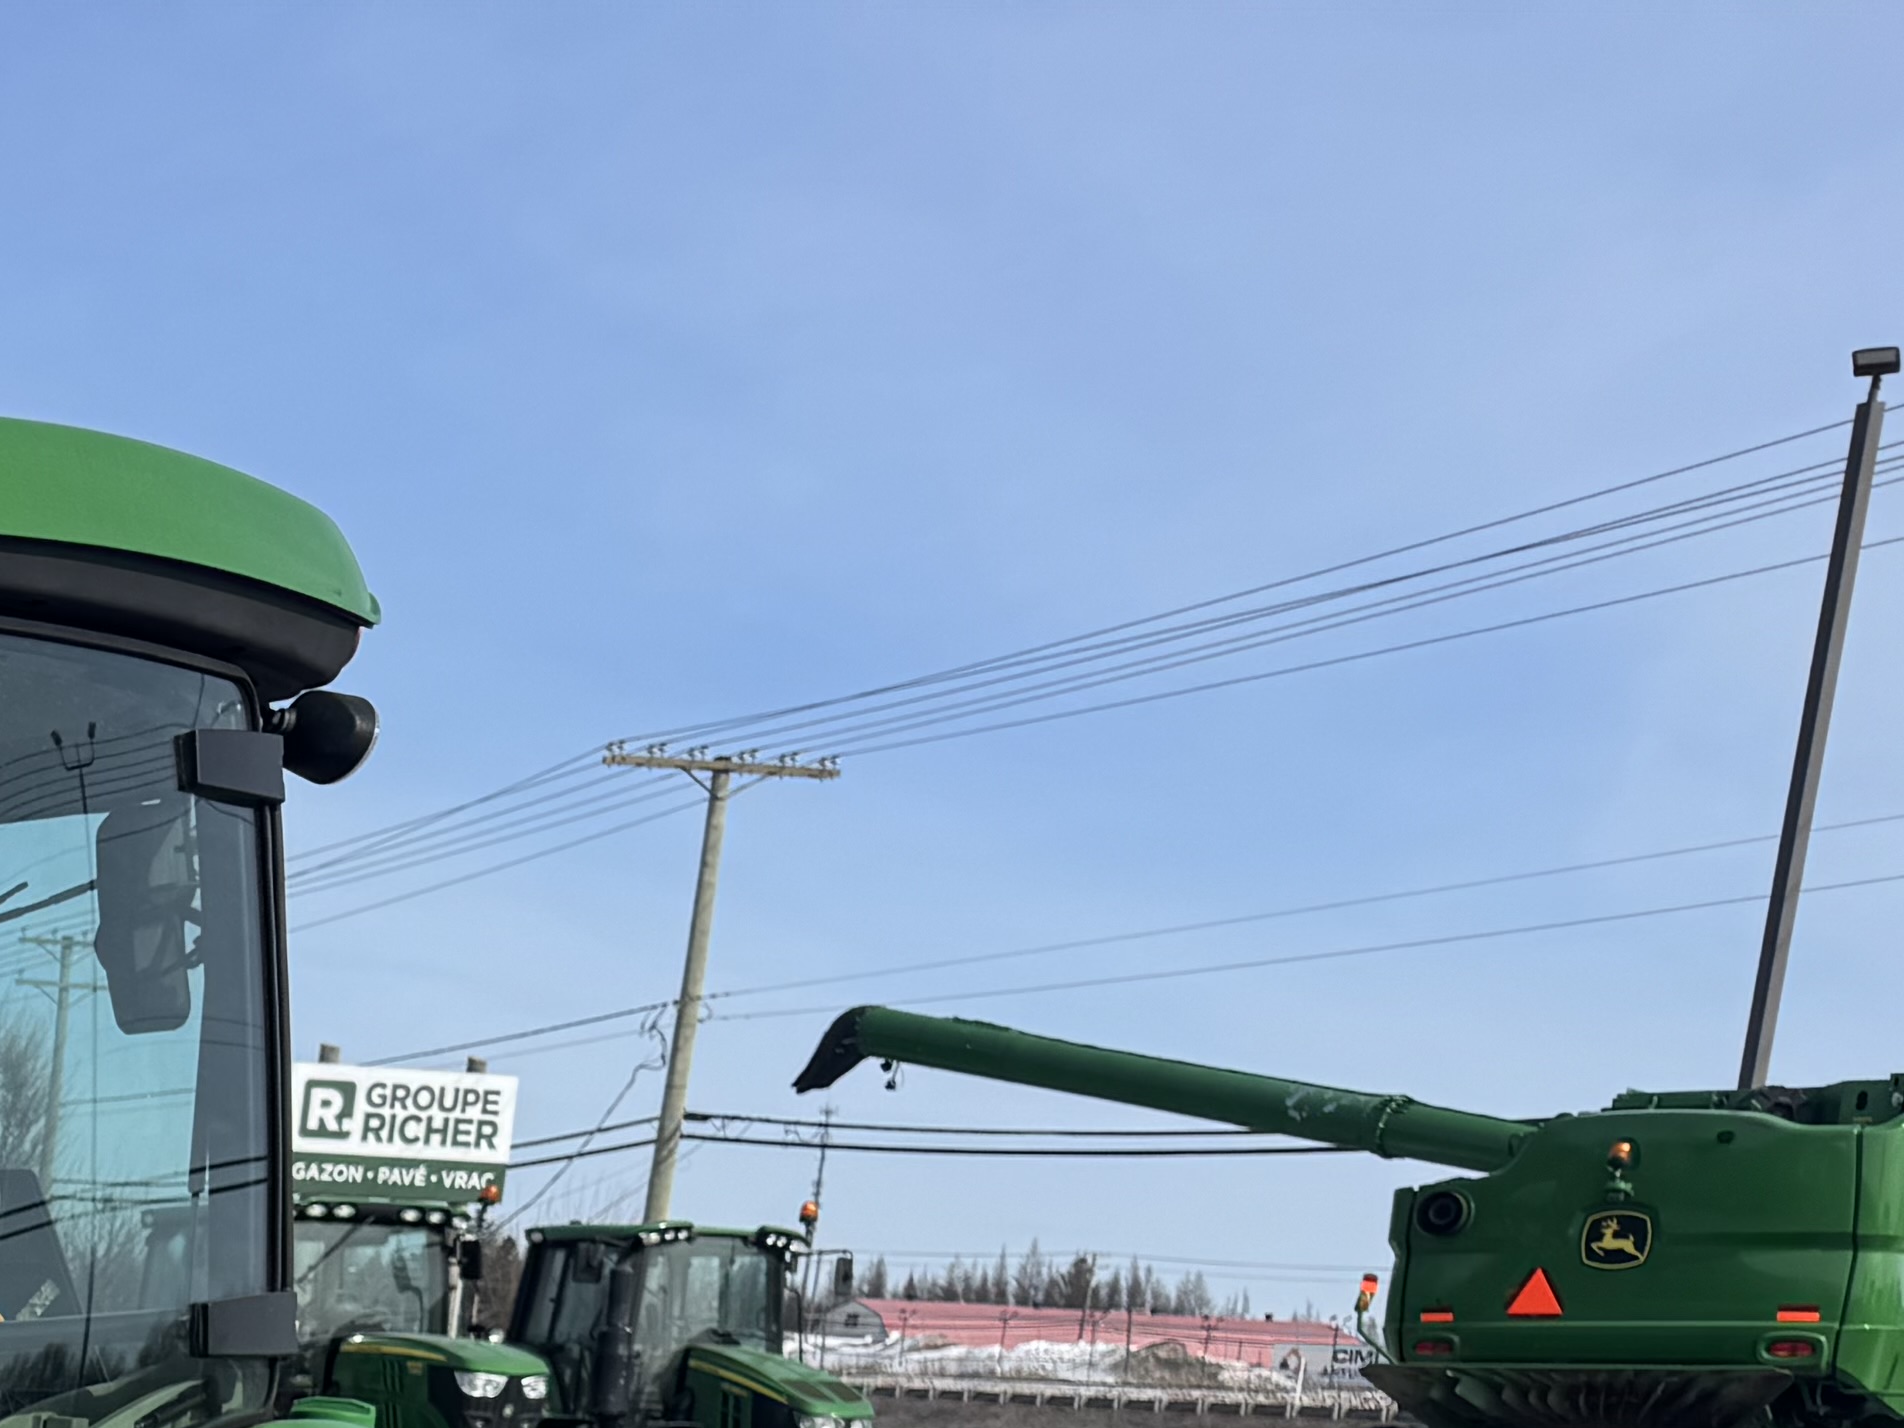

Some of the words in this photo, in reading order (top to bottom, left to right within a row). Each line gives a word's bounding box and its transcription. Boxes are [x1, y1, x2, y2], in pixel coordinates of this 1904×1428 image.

[366, 1082, 502, 1116] GROUPE
[360, 1113, 499, 1150] RICHER
[292, 1161, 364, 1183] GAZON
[377, 1163, 427, 1187] PAVÉ
